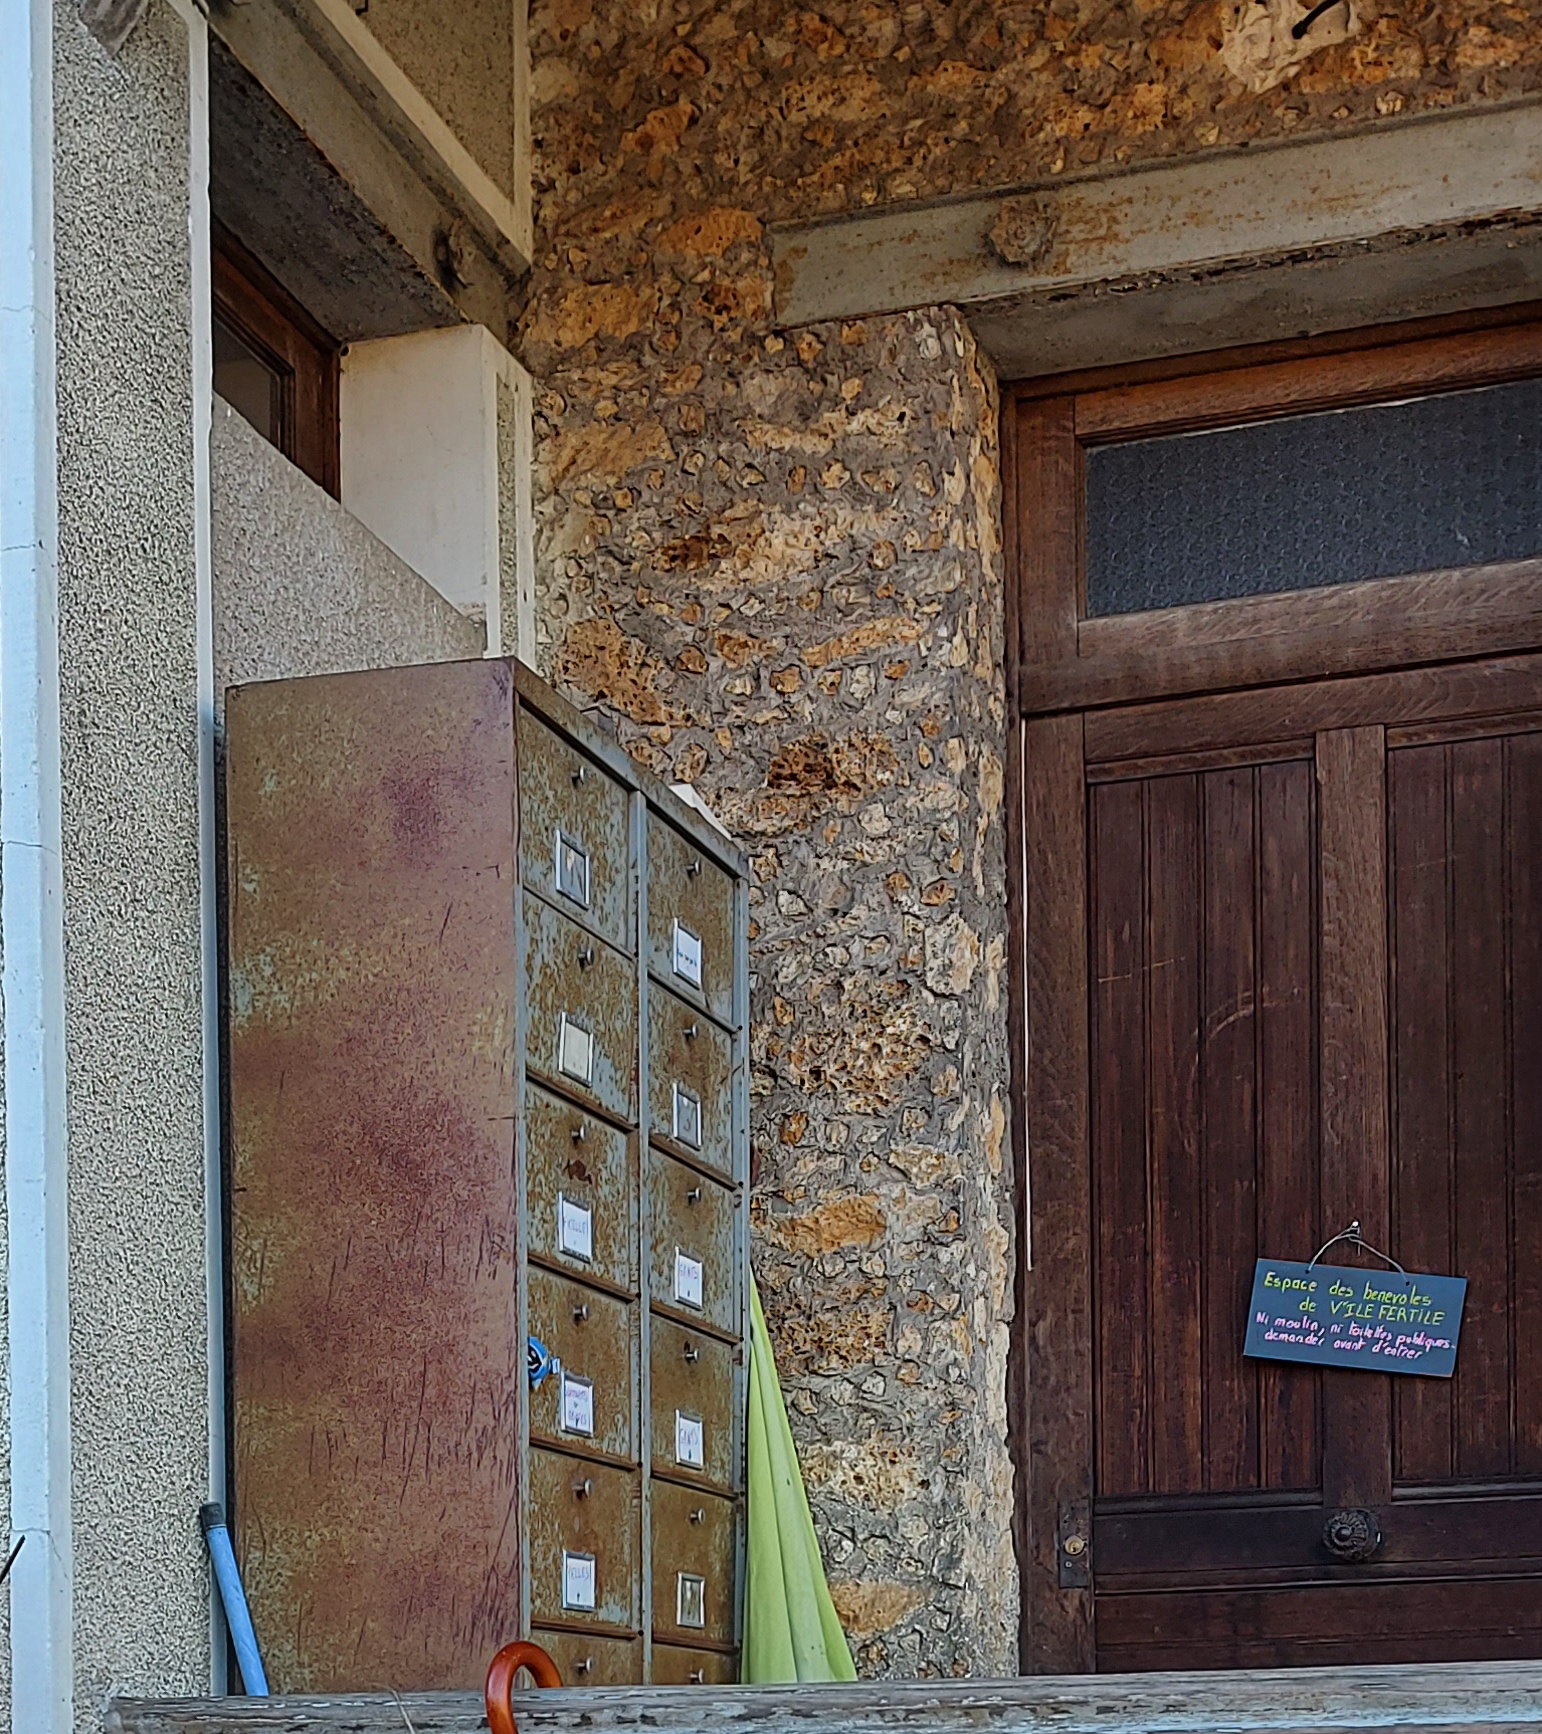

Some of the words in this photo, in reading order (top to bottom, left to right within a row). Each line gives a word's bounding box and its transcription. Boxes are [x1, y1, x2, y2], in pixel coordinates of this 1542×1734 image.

[1264, 1271, 1318, 1294] Espace
[1329, 1279, 1354, 1297] des
[1299, 1296, 1316, 1313] de
[1256, 1311, 1269, 1325] Ni
[1330, 1323, 1344, 1335] ni
[1264, 1328, 1325, 1347] demander
[1333, 1335, 1367, 1350] avant
[1372, 1339, 1423, 1360] d'entrer
